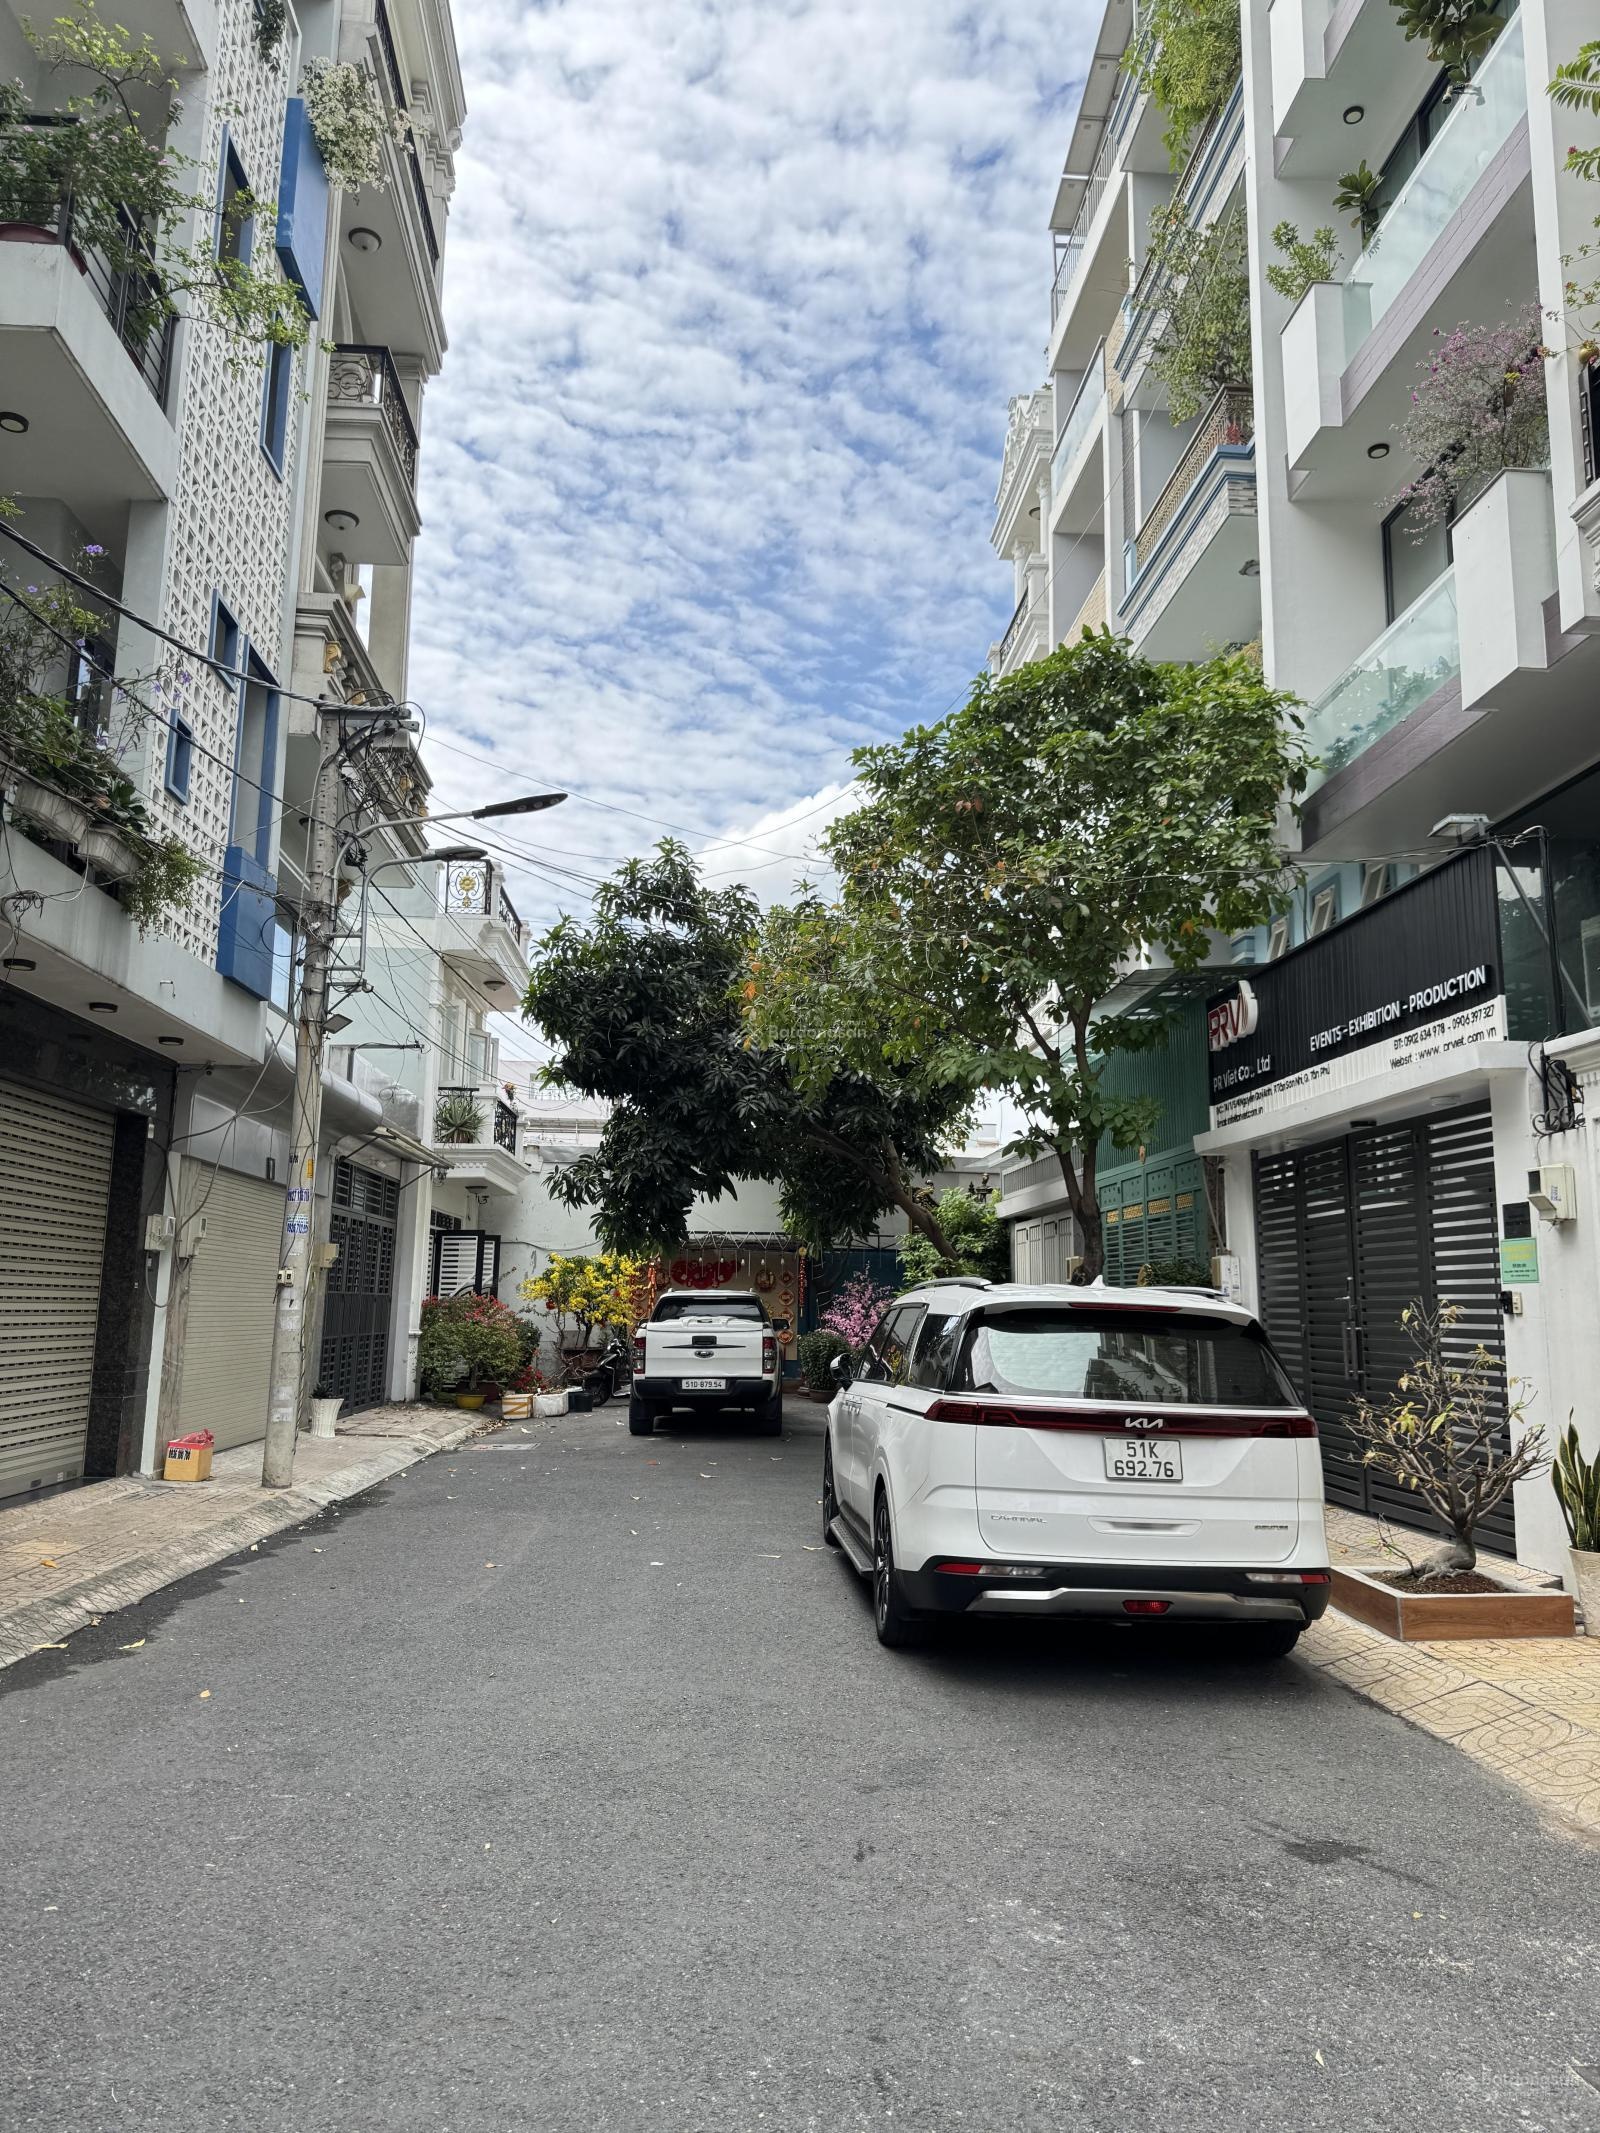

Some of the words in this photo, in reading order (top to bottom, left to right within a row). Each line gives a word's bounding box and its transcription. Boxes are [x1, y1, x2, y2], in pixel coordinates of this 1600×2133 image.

[1310, 1026, 1343, 1052] EVENTS
[1348, 1000, 1401, 1037] EXHIBITION
[1409, 965, 1486, 1012] PRODUCTION
[1433, 1023, 1445, 1037] 978
[1213, 1075, 1222, 1092] PR
[1257, 1054, 1271, 1075] Ltd
[1125, 1417, 1164, 1429] KIA
[1126, 1441, 1159, 1458] 51K
[1114, 1459, 1174, 1478] 692.76
